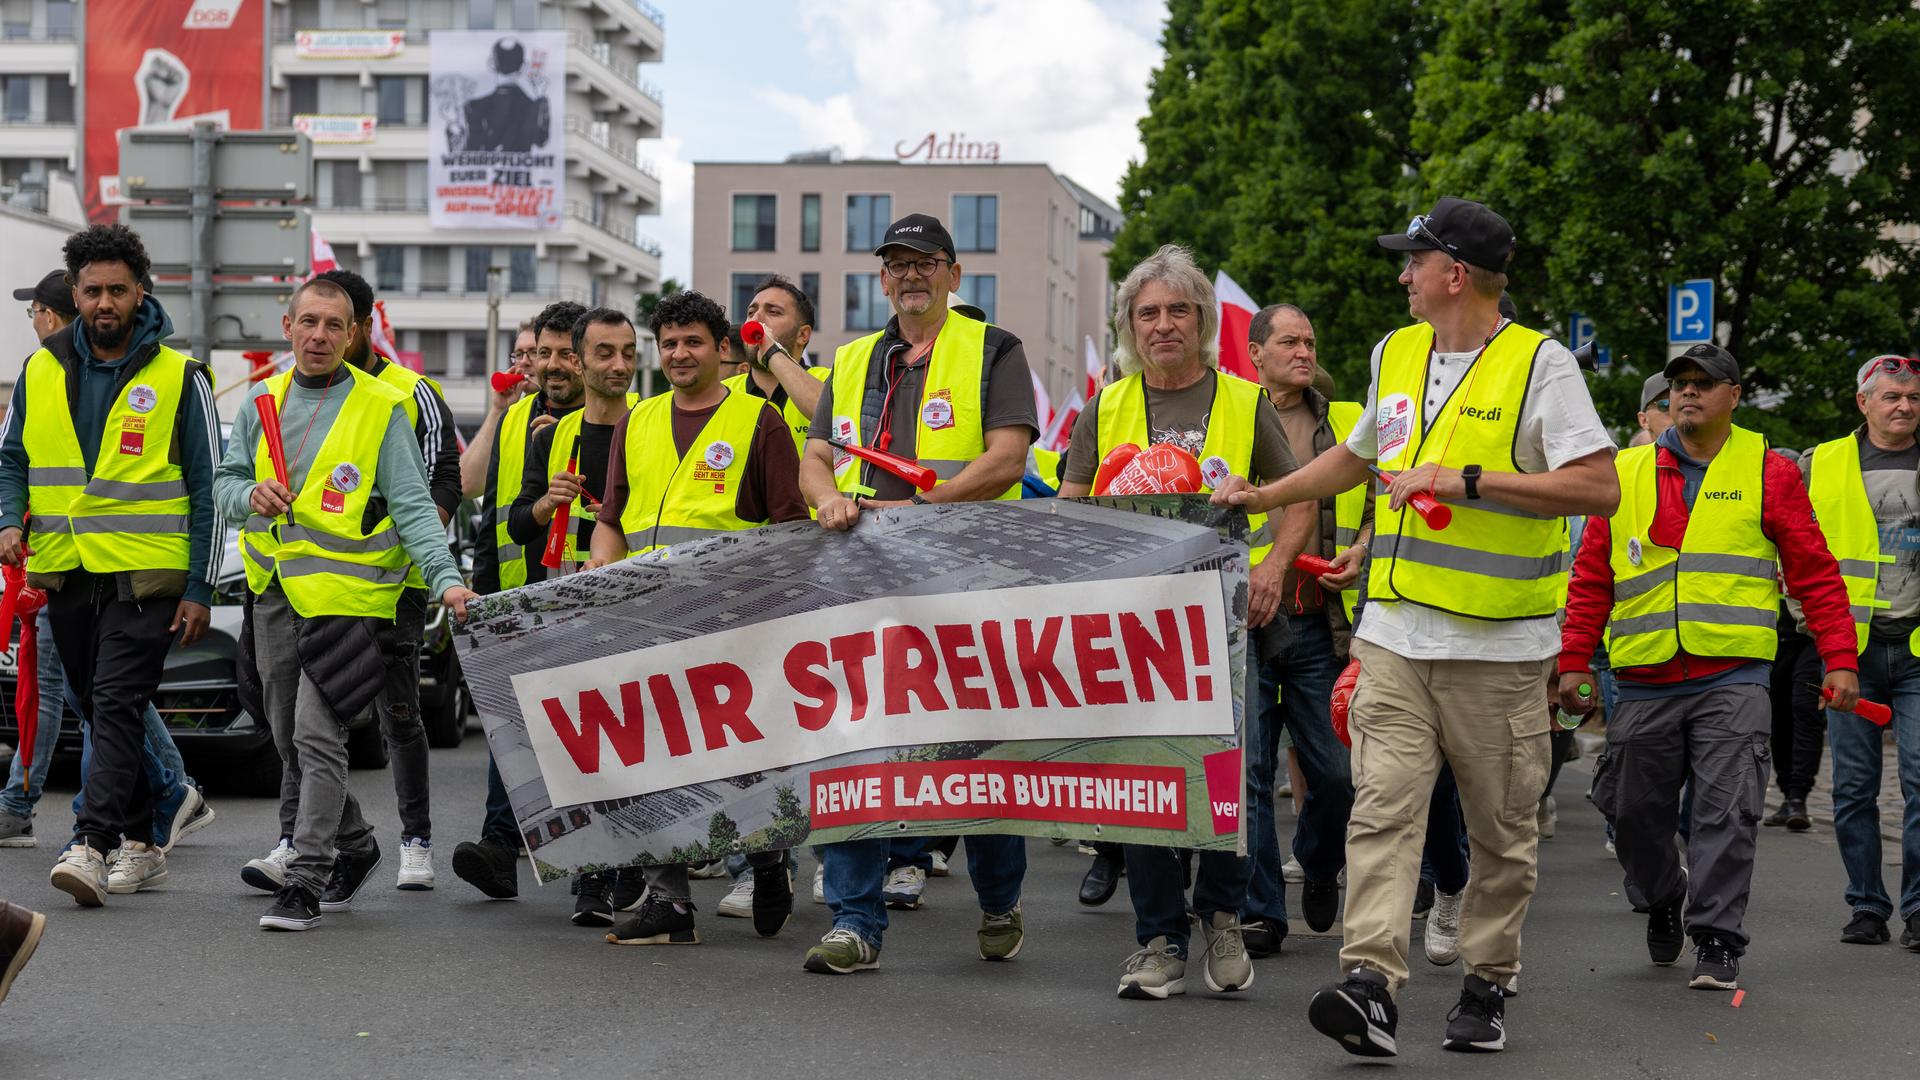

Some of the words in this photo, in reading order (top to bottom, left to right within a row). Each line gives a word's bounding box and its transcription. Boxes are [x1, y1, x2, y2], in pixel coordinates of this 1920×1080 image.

[193, 9, 229, 22] DGB
[895, 132, 1000, 160] Adina
[442, 155, 555, 167] WEHRPFLICHT
[493, 170, 532, 186] ZIEL
[895, 226, 923, 234] ver.di
[1676, 289, 1700, 335] P
[1459, 406, 1501, 421] ver.di
[795, 425, 809, 434] ve
[121, 443, 142, 453] ver.di
[1704, 490, 1742, 501] ver.di
[322, 501, 343, 512] ver.di
[541, 661, 765, 775] WIR
[783, 604, 1213, 731] STREIKEN!
[816, 777, 881, 815] REWE
[894, 773, 1007, 807] LAGER
[1013, 774, 1178, 815] BUTTENHEIM
[1213, 801, 1239, 817] ver
